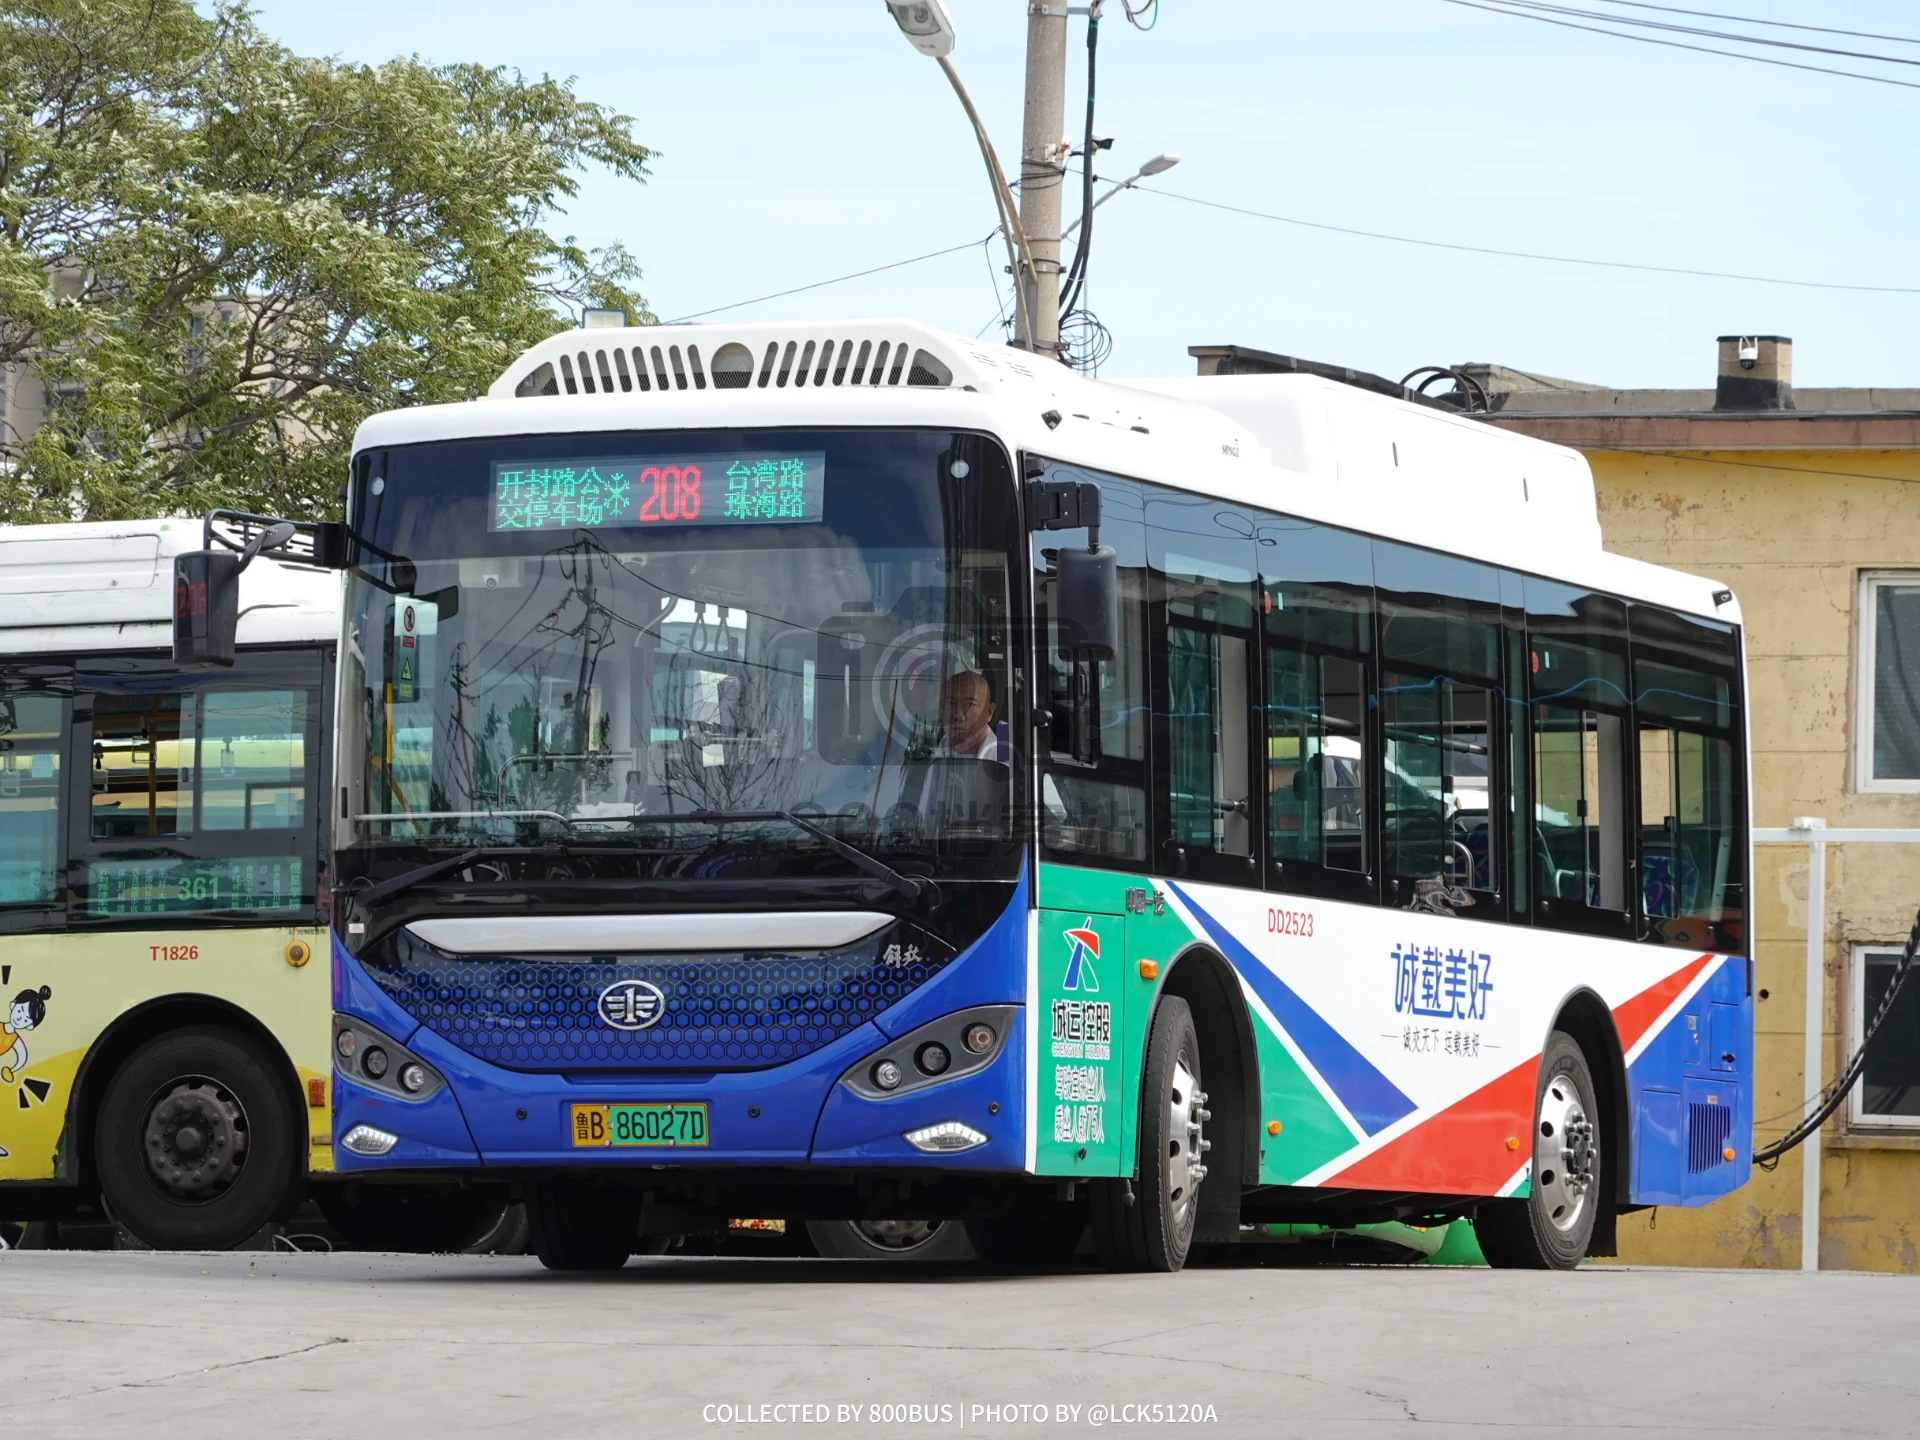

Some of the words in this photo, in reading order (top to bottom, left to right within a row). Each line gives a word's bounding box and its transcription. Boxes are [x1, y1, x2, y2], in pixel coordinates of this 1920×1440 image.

[498, 466, 603, 500] 开封路公
[725, 458, 804, 490] 台湾路
[639, 465, 701, 522] 208
[724, 488, 806, 519] 珠海路
[496, 497, 604, 529] 交停车场
[177, 582, 207, 619] 208
[178, 875, 219, 902] 361
[1268, 908, 1315, 938] DD2523
[150, 945, 199, 961] T1826
[1390, 943, 1494, 1021] 诚载美好
[1052, 1000, 1111, 1043] 城运控股
[1085, 1044, 1111, 1061] HOLDING
[1444, 1030, 1481, 1059] 运载美好
[575, 1111, 604, 1140] 鲁B
[616, 1110, 705, 1140] 86027D
[1054, 1104, 1105, 1144] 乘坐人数75人
